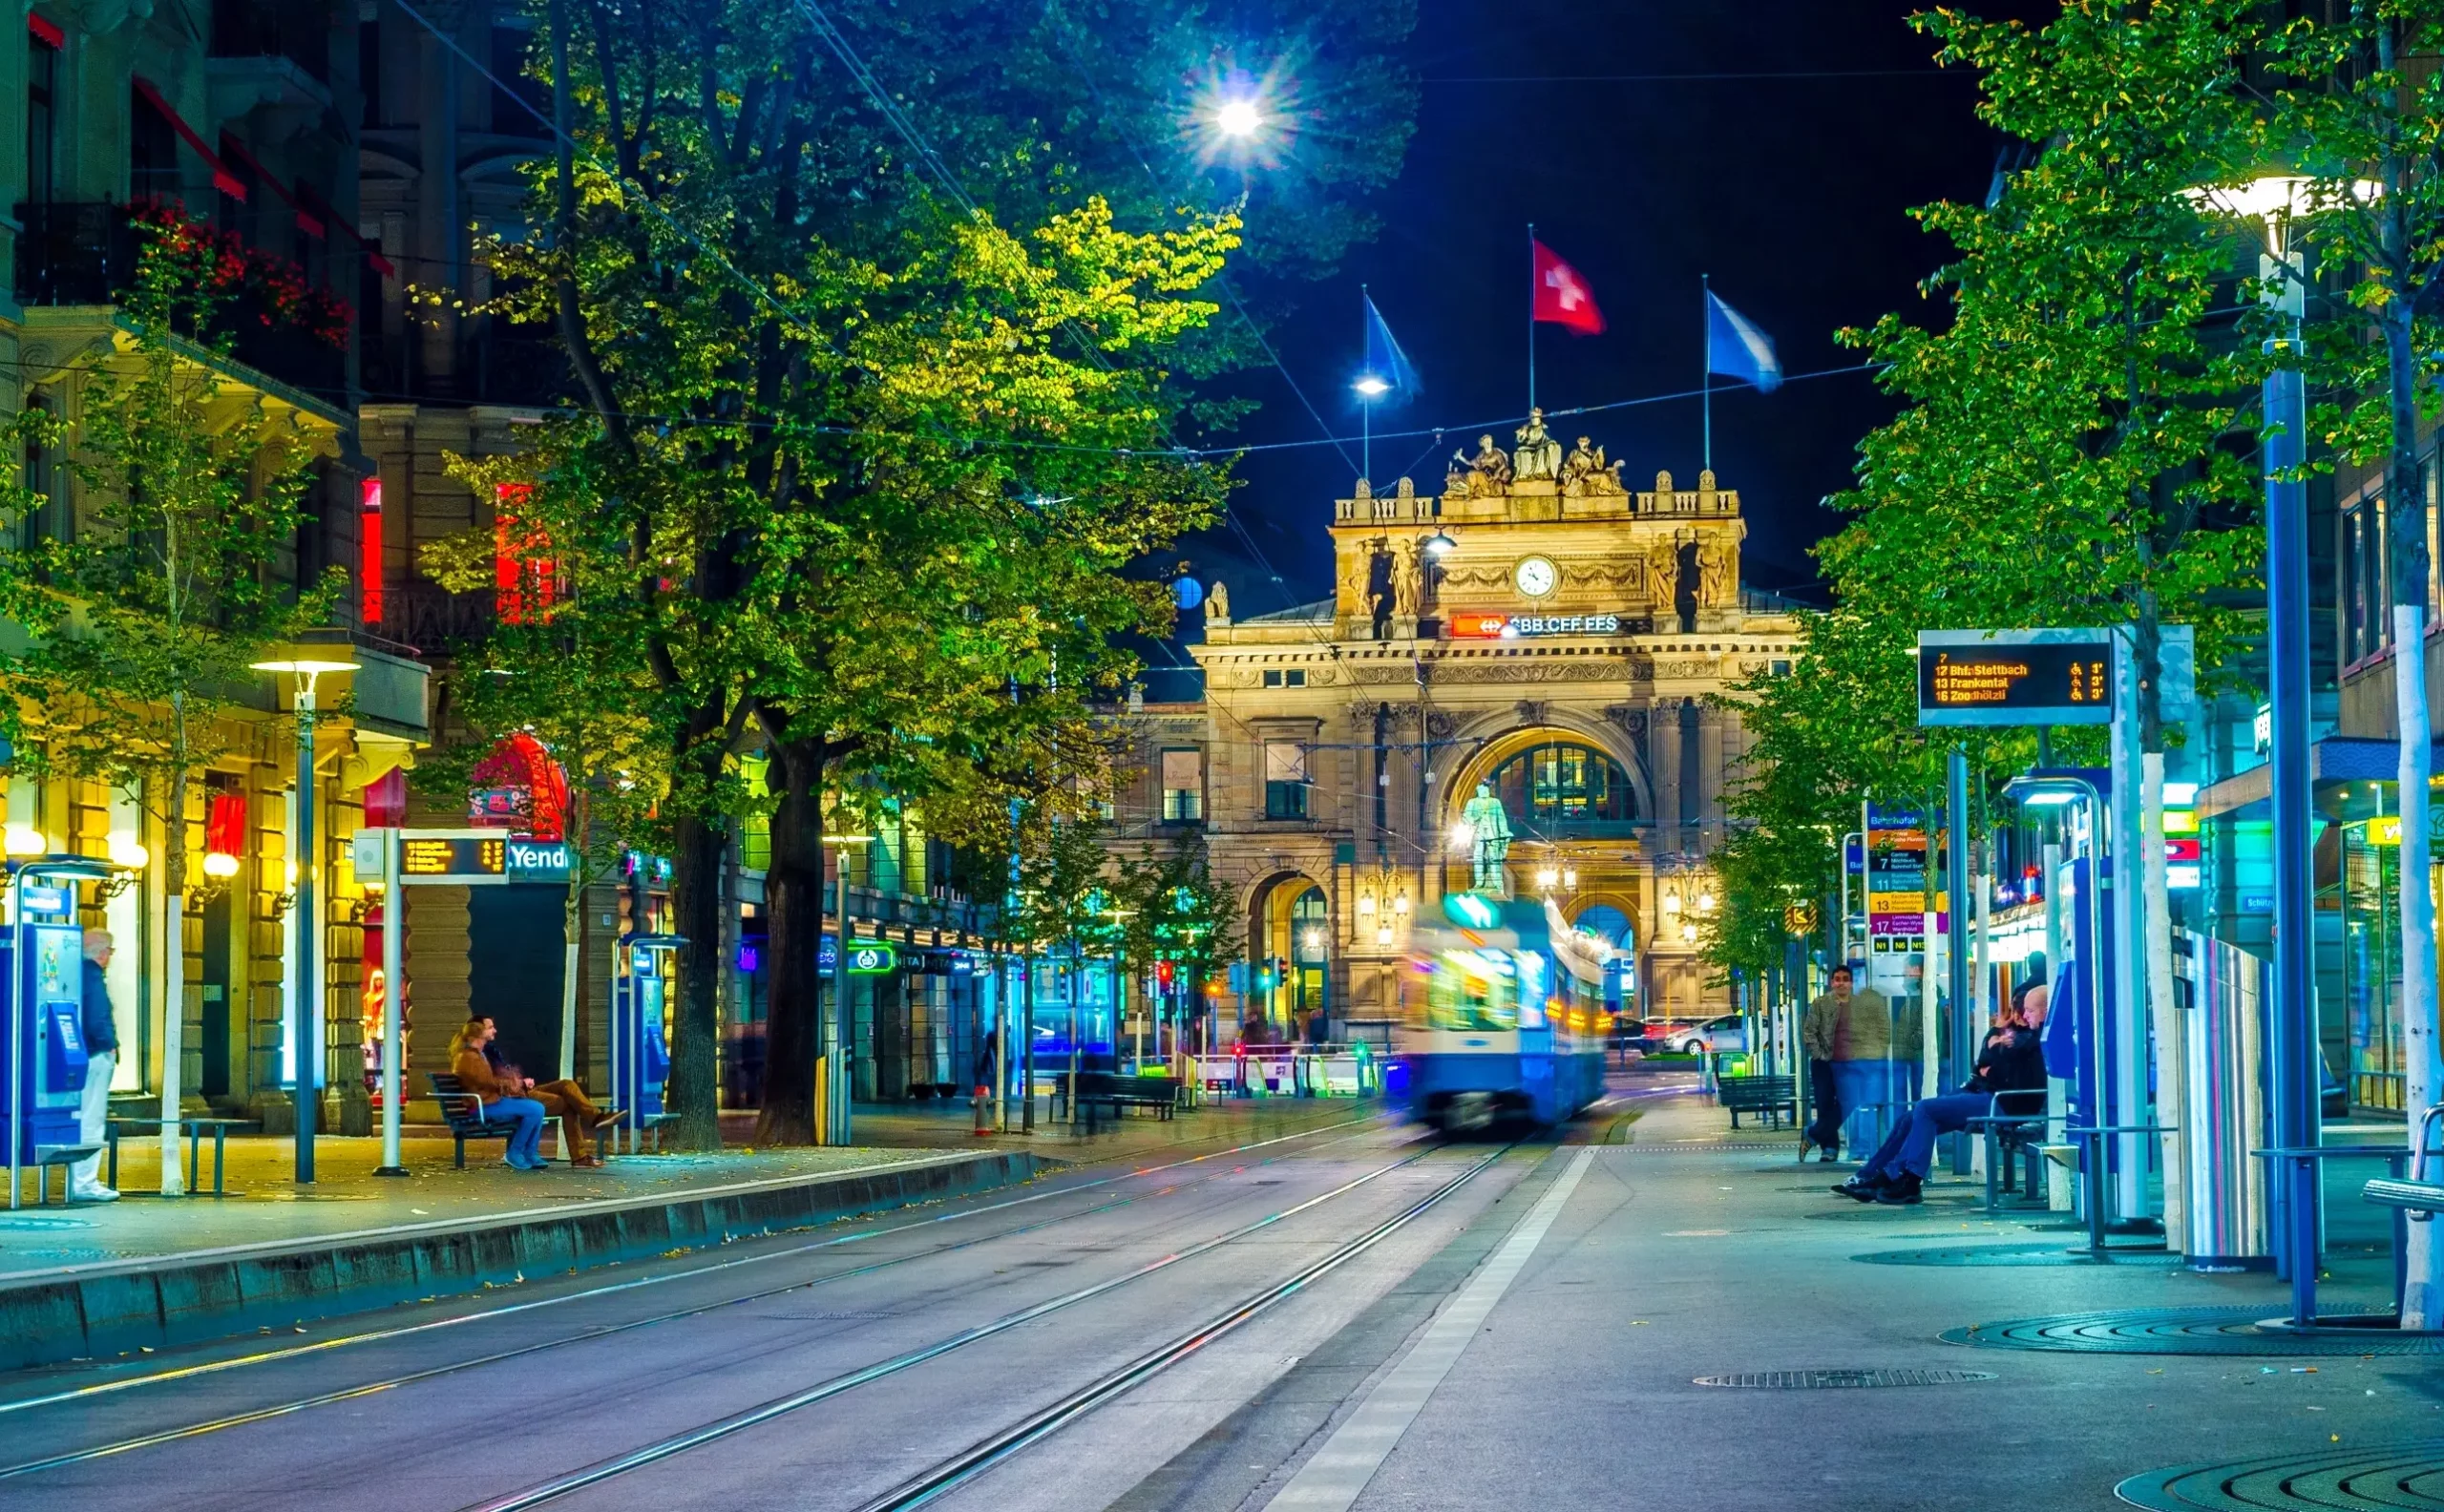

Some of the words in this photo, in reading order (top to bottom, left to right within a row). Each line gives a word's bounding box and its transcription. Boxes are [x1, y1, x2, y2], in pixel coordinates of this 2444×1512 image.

[1935, 678, 1949, 689] 13
[1880, 859, 1888, 870] 7
[1877, 879, 1889, 891] 11
[1876, 901, 1889, 912] 13
[1876, 921, 1889, 933] 17
